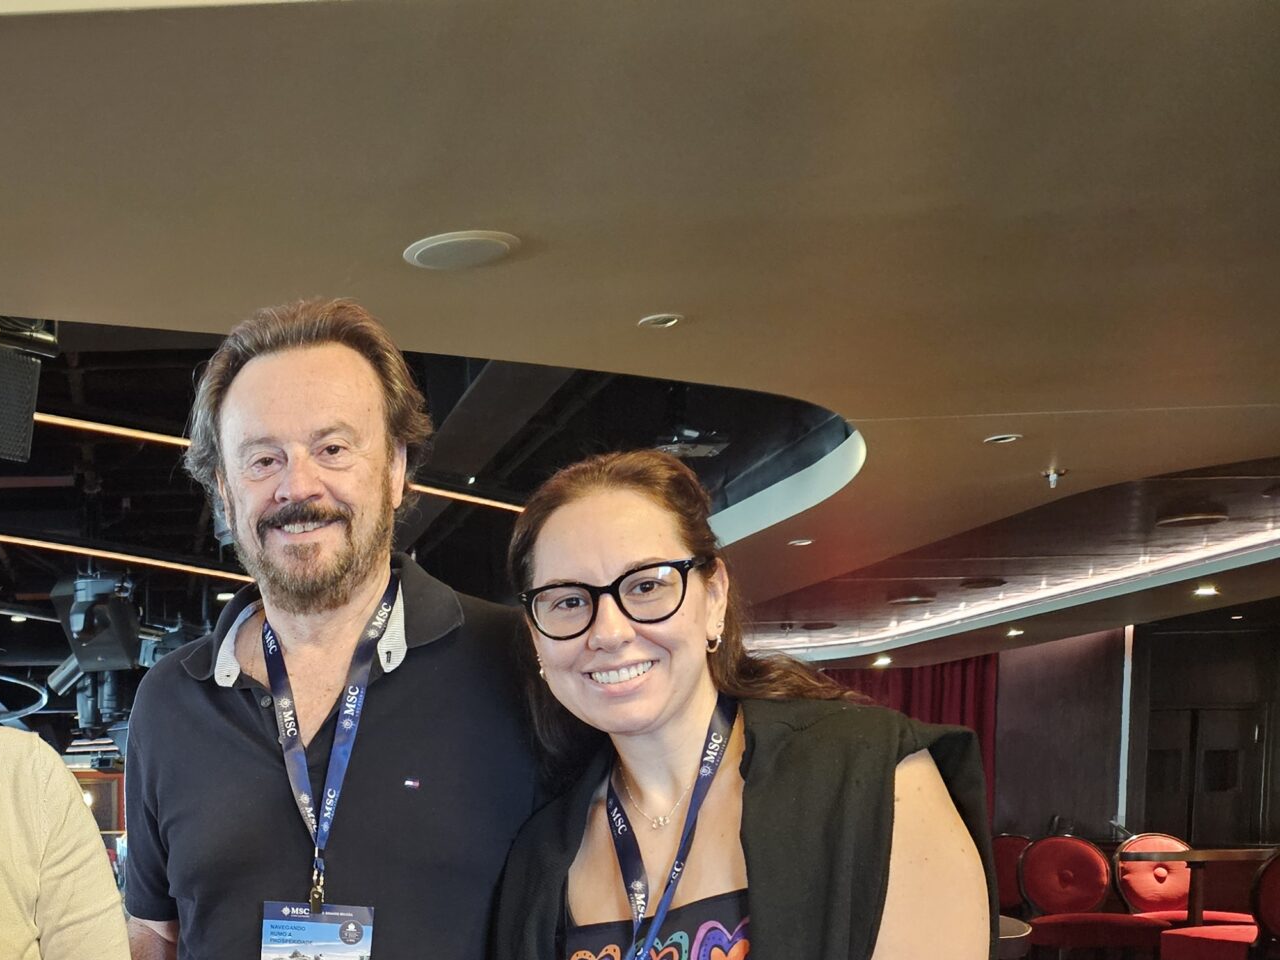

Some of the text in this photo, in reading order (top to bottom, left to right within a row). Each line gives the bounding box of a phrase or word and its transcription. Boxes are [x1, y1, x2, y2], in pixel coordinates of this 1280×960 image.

[372, 602, 391, 628] MSC
[265, 630, 277, 655] MSC
[343, 685, 360, 716] MSC
[283, 710, 297, 737] MSC
[702, 732, 723, 763] MSC
[323, 788, 336, 818] MSC
[610, 806, 627, 835] MSC
[291, 907, 310, 915] MSC
